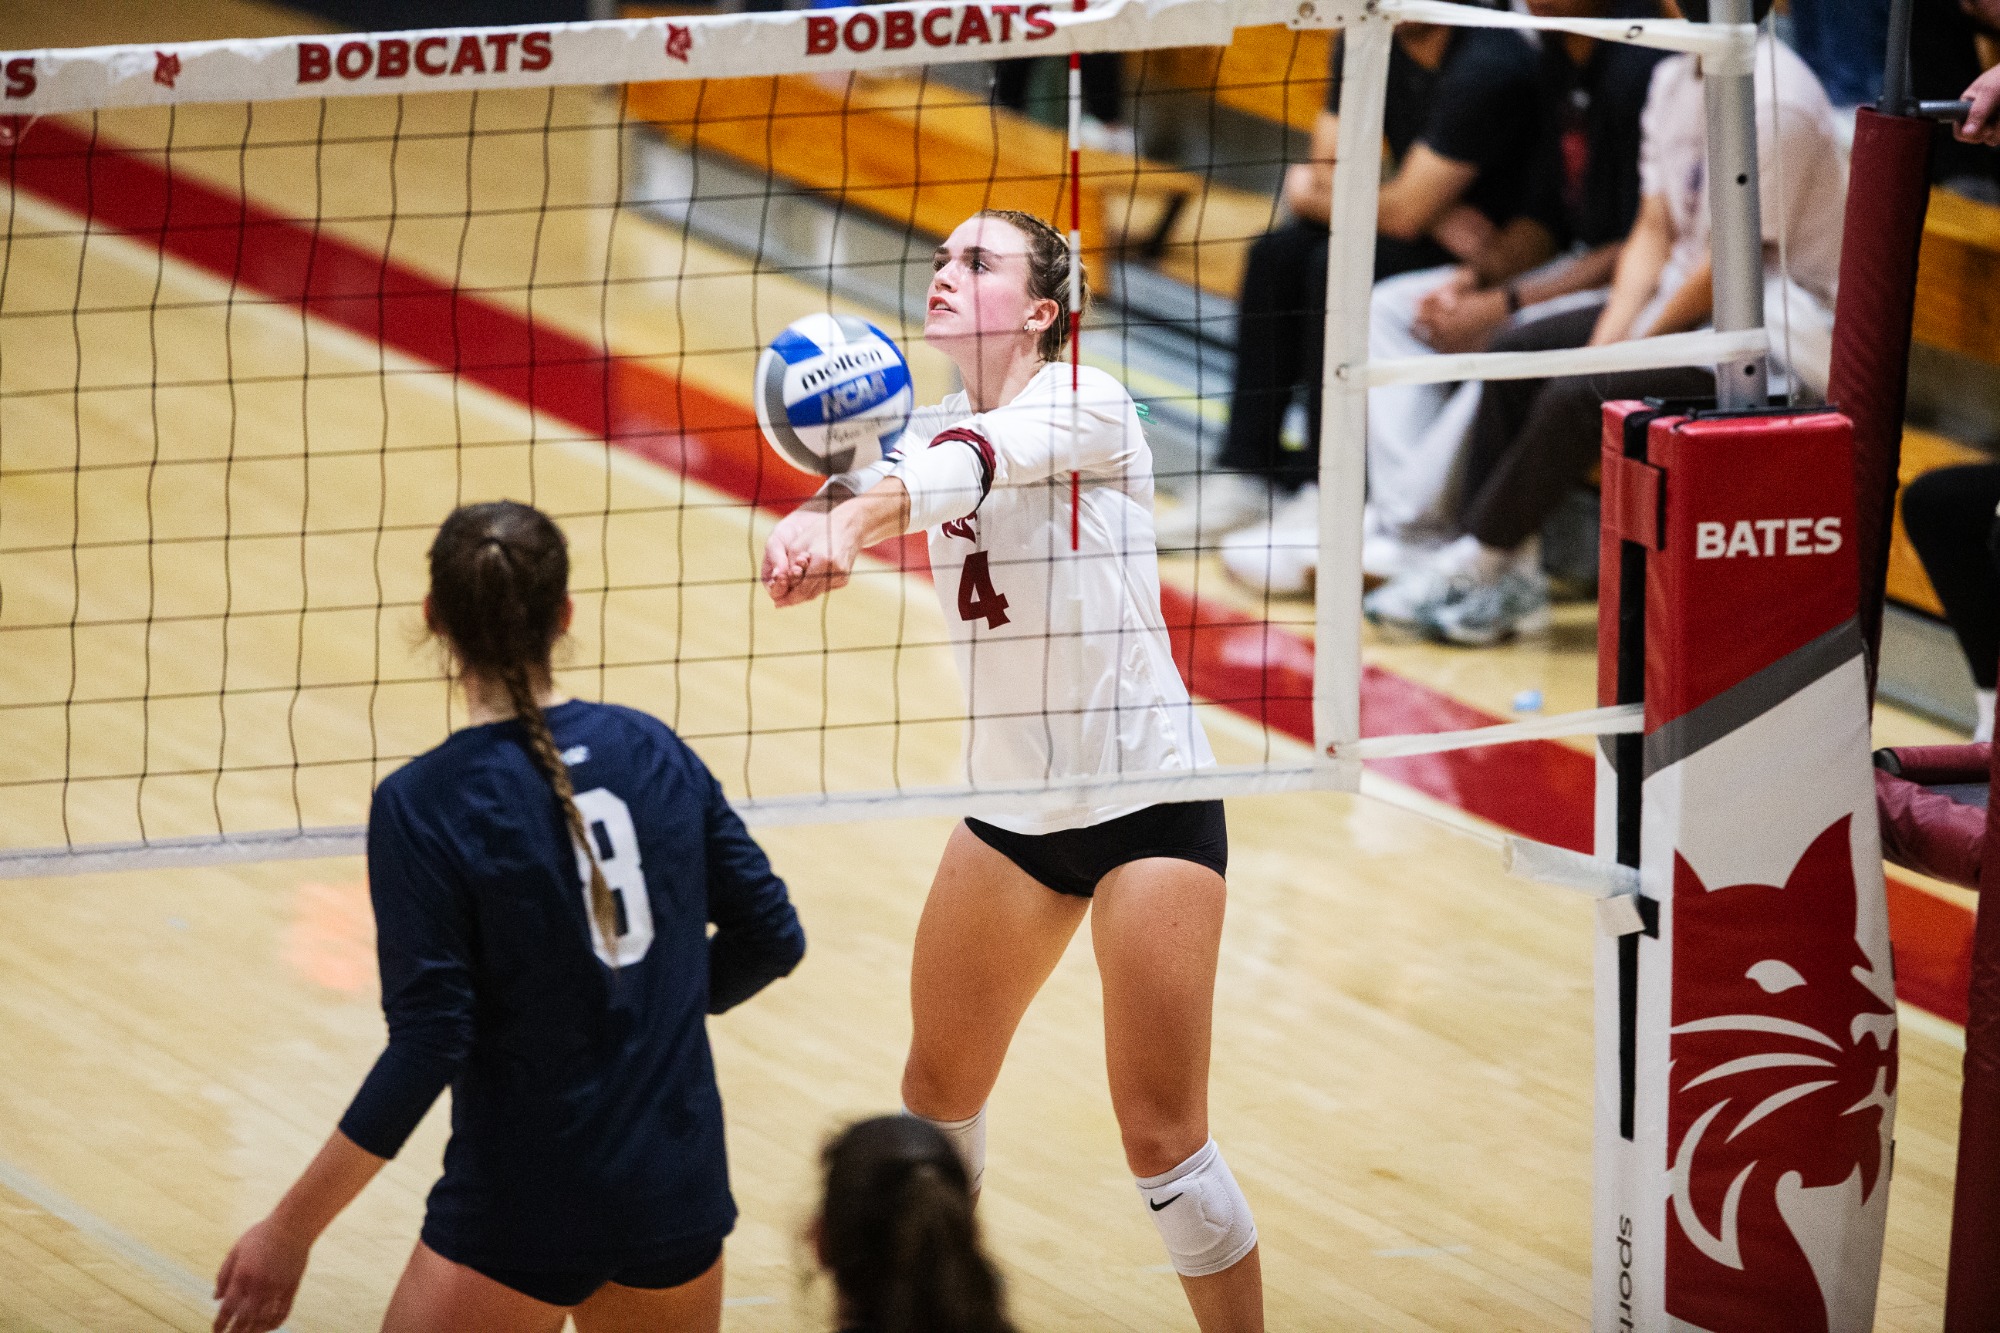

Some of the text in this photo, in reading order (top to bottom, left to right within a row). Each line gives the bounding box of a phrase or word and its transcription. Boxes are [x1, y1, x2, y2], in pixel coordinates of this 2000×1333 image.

[805, 4, 1057, 55] BOBCATS
[297, 31, 553, 84] BOBCATS
[801, 349, 884, 391] molten
[1696, 516, 1843, 560] BATES
[957, 550, 1011, 630] 4
[567, 787, 655, 969] 8
